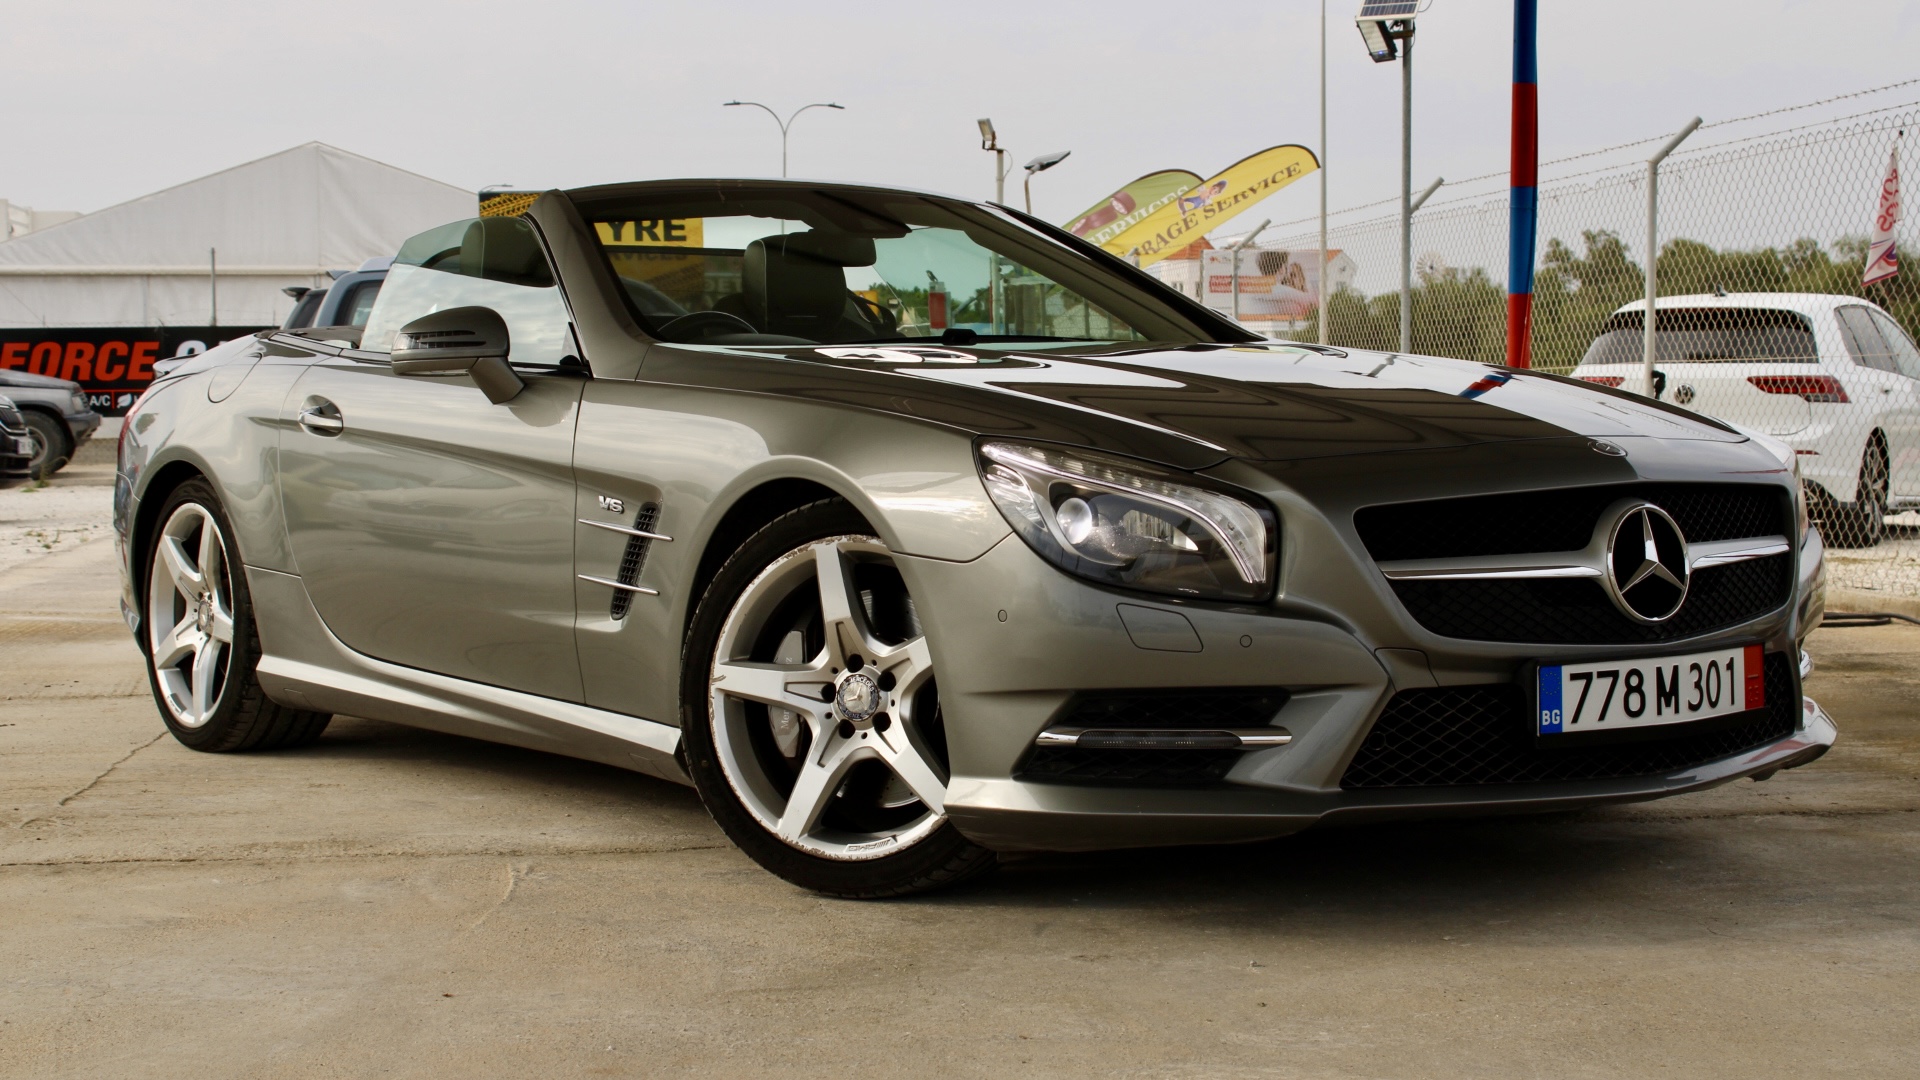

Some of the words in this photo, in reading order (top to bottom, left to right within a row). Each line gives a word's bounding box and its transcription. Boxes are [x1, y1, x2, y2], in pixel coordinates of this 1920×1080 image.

[1116, 213, 1199, 257] RAGE
[1203, 162, 1301, 220] SERVICE
[607, 218, 687, 242] YRE
[0, 341, 160, 381] FORCE
[90, 393, 111, 407] A/C
[1569, 668, 1646, 724] 778
[1656, 665, 1679, 716] M
[1688, 656, 1735, 712] 301
[1542, 709, 1561, 725] BG
